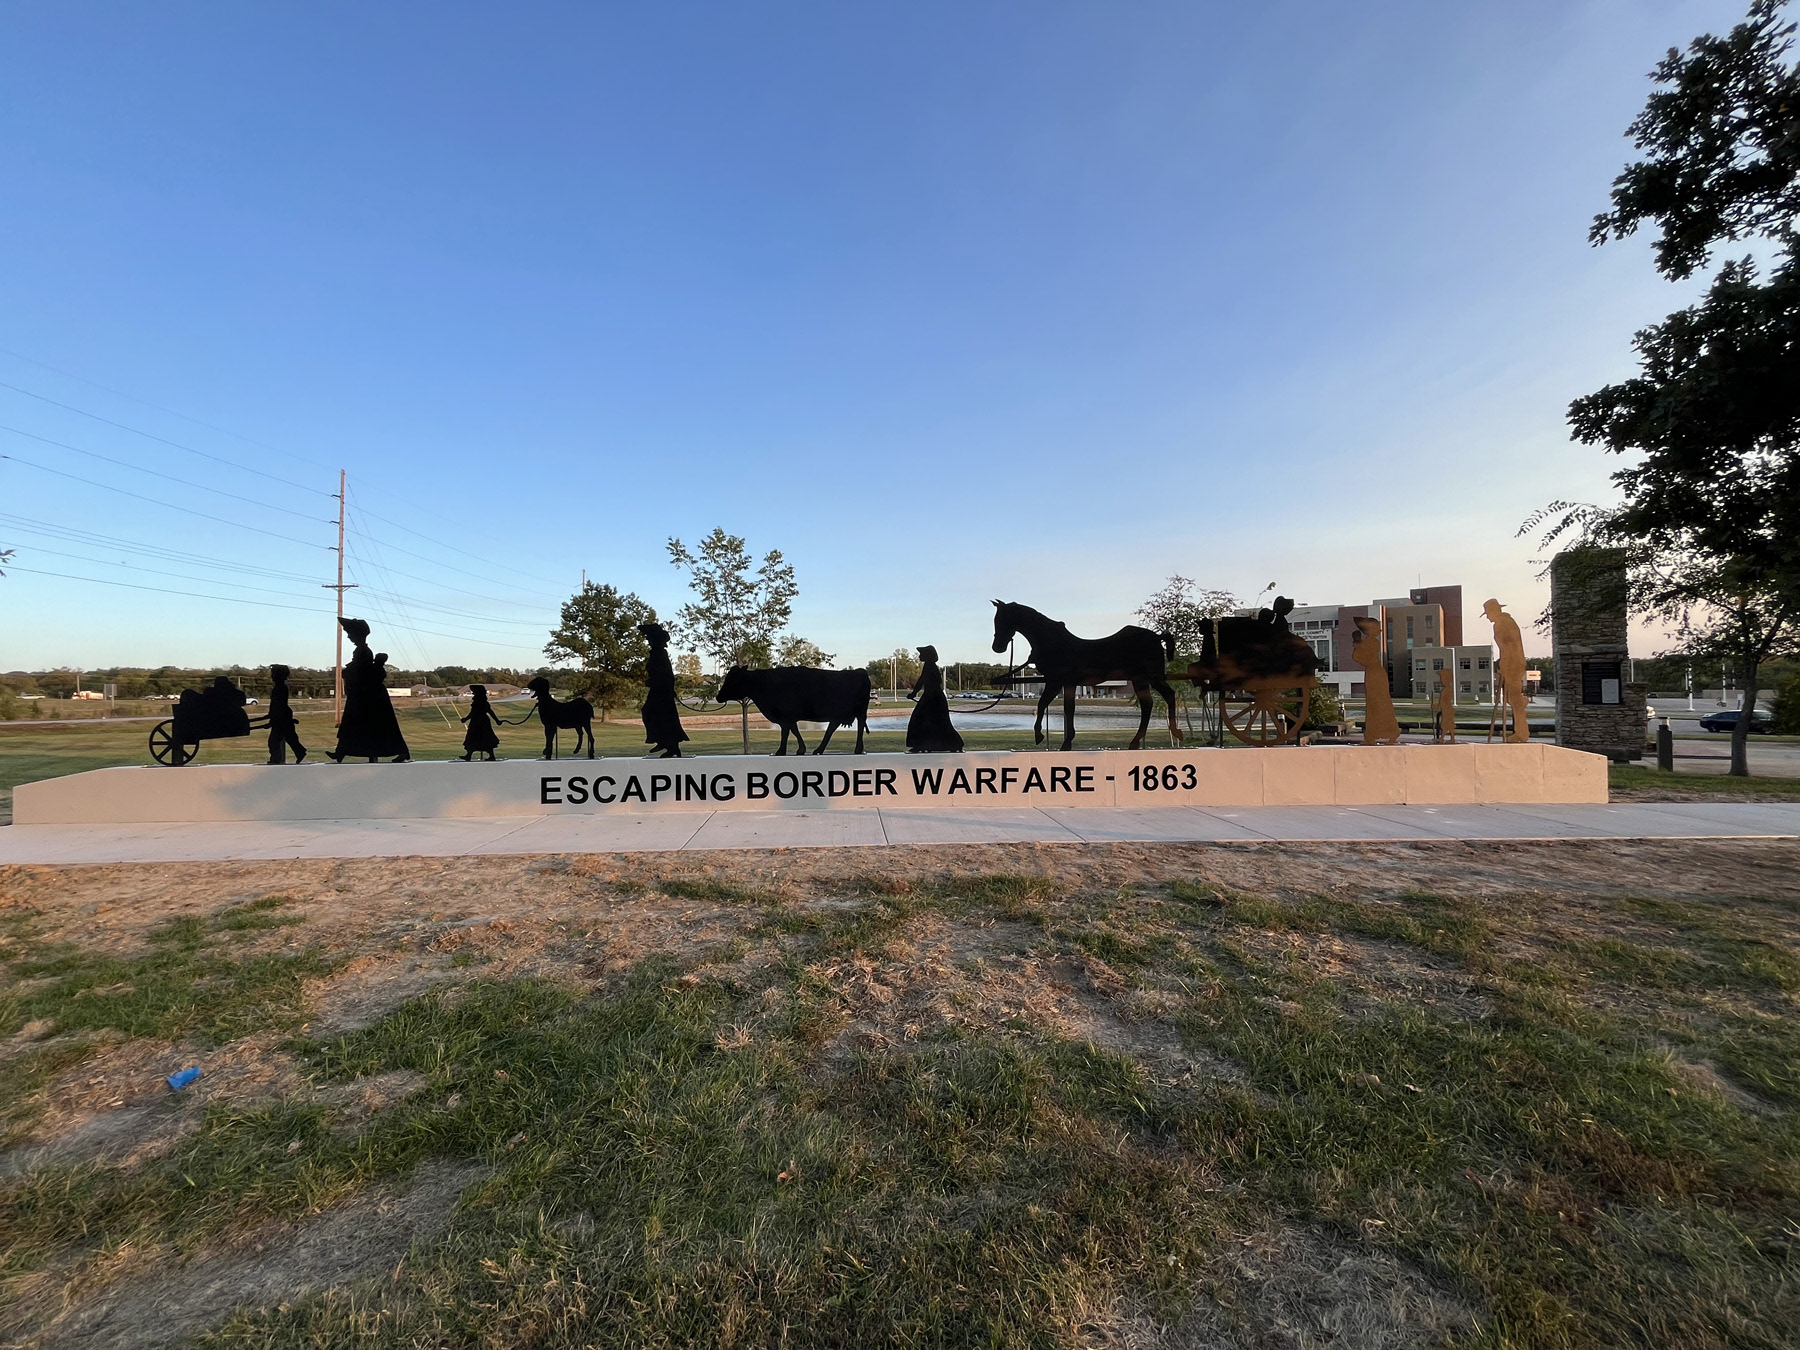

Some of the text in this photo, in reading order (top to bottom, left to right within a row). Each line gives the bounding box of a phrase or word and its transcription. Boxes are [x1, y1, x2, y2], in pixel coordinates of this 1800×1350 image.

[541, 774, 735, 804] ESCAPING
[748, 769, 897, 798] BORDER
[913, 767, 1095, 794] WARFARE
[1129, 765, 1197, 791] 1863
